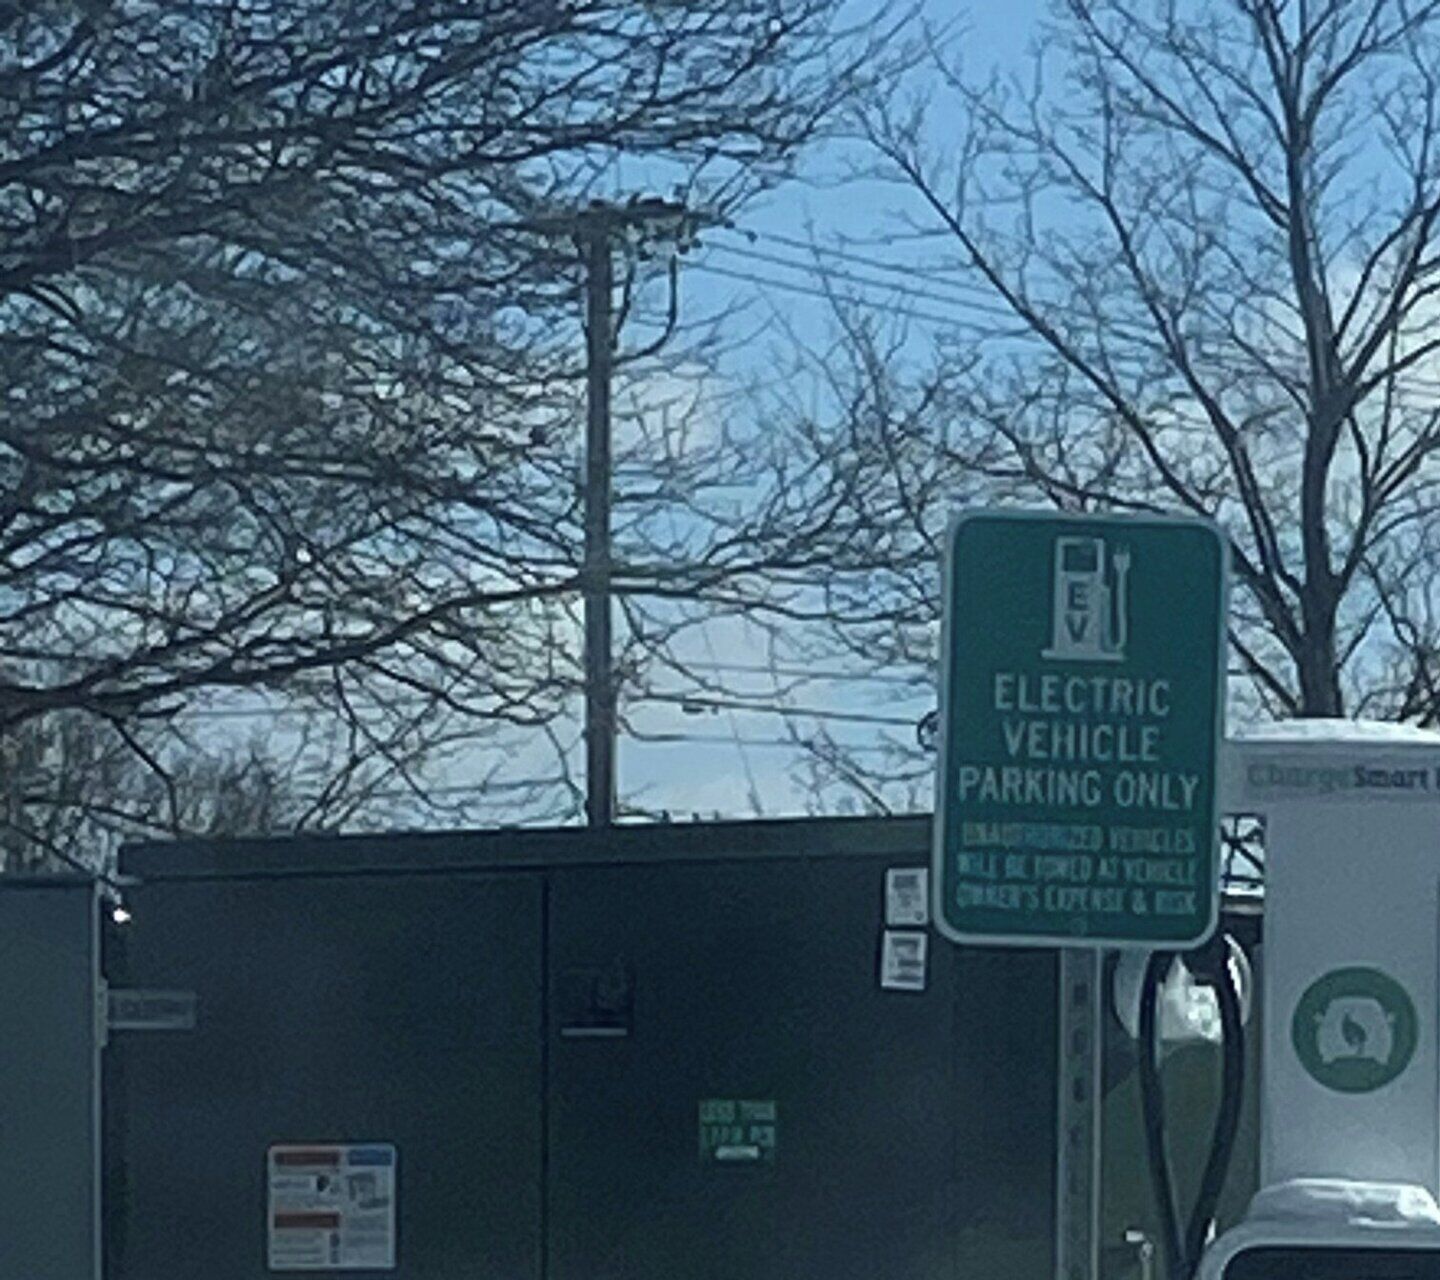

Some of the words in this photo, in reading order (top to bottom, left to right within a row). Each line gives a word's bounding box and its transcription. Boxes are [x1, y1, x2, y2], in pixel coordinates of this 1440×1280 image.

[994, 672, 1170, 717] ELECTRIC
[1003, 721, 1160, 762] VEHICLE
[959, 766, 1101, 807] PARKING
[1114, 772, 1199, 810] ONLY
